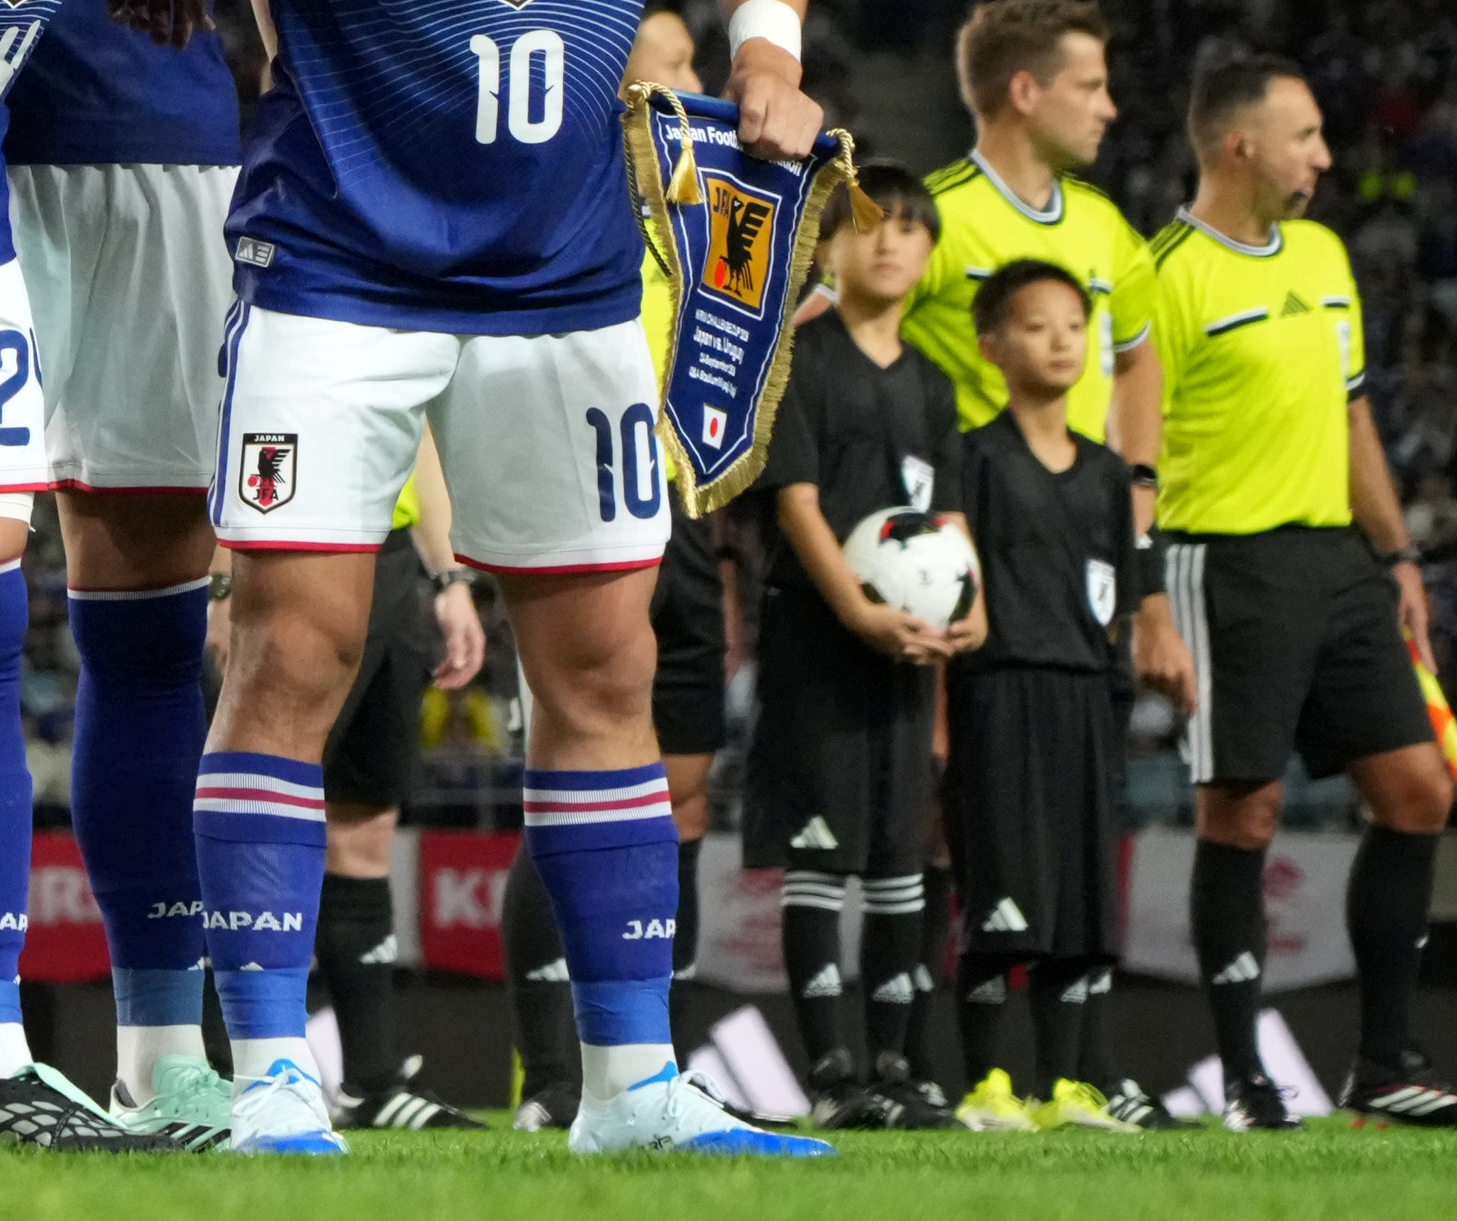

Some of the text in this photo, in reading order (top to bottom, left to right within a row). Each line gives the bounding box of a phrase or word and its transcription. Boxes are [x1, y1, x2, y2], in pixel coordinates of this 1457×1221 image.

[469, 30, 565, 145] 10
[665, 124, 706, 143] Jaan
[254, 434, 285, 443] JAPAN
[585, 403, 662, 523] 10
[147, 901, 204, 919] JAP
[202, 911, 302, 932] JAPAN
[622, 919, 676, 940] JAP
